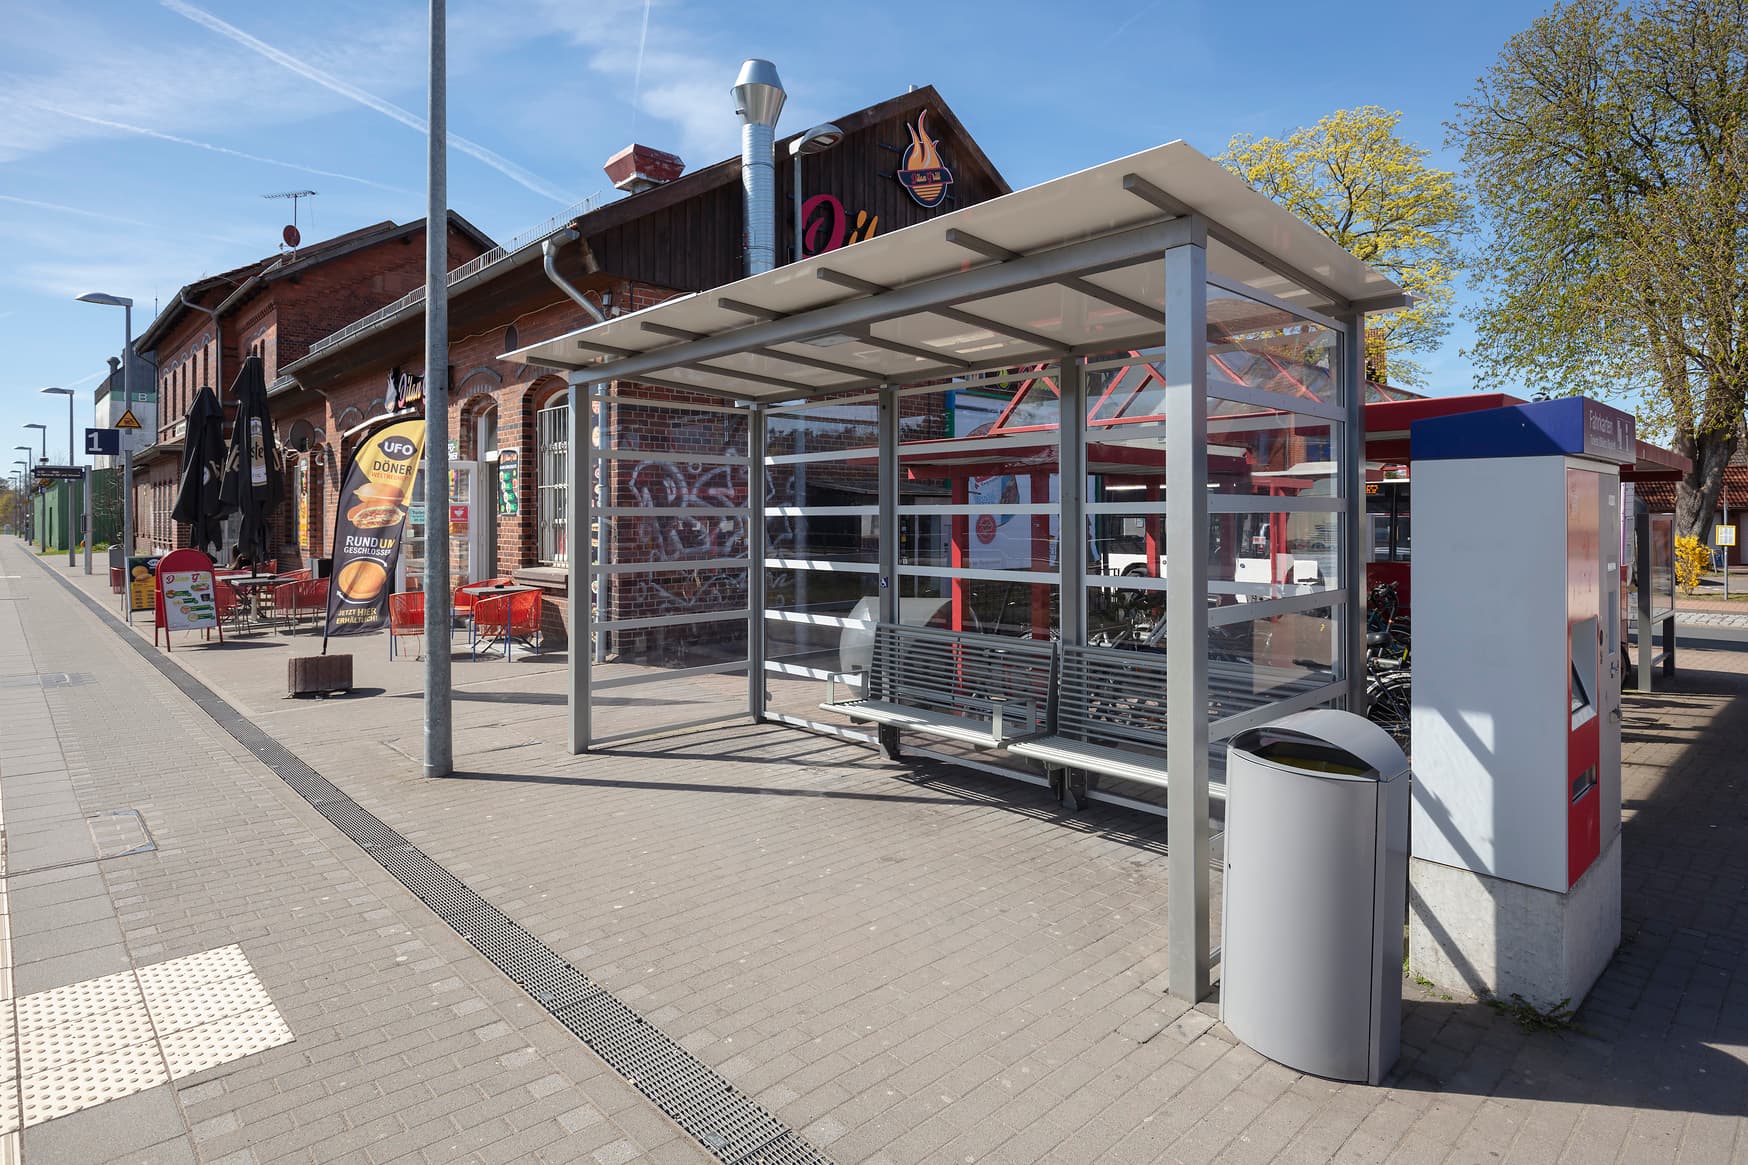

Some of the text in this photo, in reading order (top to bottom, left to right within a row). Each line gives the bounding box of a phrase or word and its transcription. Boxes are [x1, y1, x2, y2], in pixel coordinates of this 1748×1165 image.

[88, 431, 103, 451] 1
[384, 441, 413, 456] UFO
[373, 459, 413, 476] DÖNER
[345, 535, 379, 548] RUND
[356, 607, 377, 617] HIER
